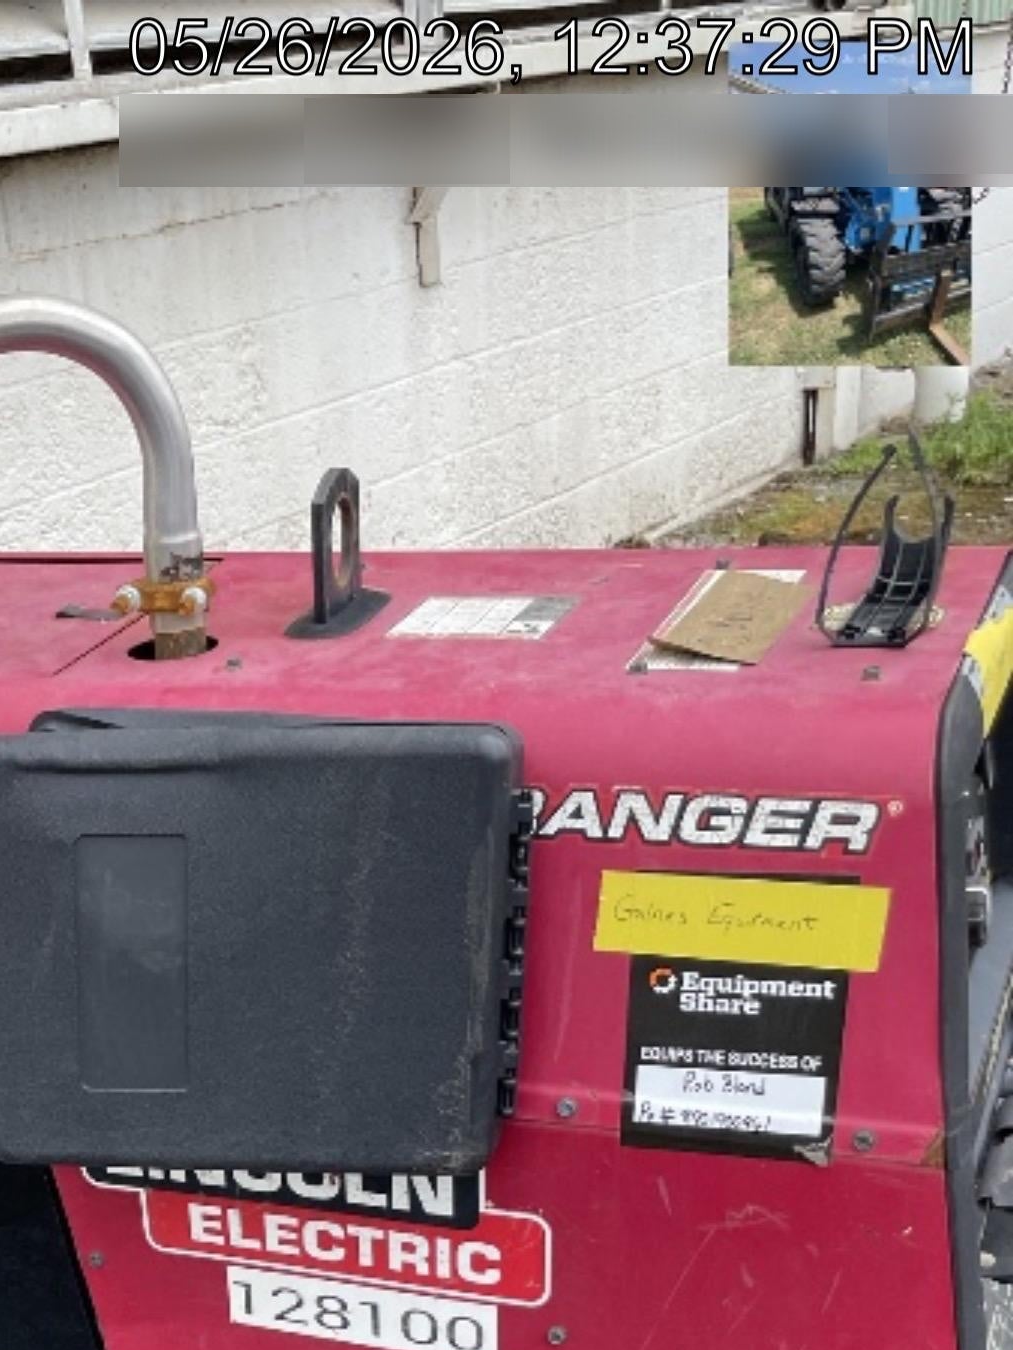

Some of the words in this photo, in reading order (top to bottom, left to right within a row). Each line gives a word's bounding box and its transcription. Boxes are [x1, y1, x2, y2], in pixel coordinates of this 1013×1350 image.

[679, 970, 837, 999] Equipment
[678, 991, 762, 1016] Share
[697, 1049, 726, 1066] THE
[728, 1051, 798, 1070] SUCCESS
[800, 1054, 823, 1071] OF
[188, 1203, 503, 1285] ELECTRIC
